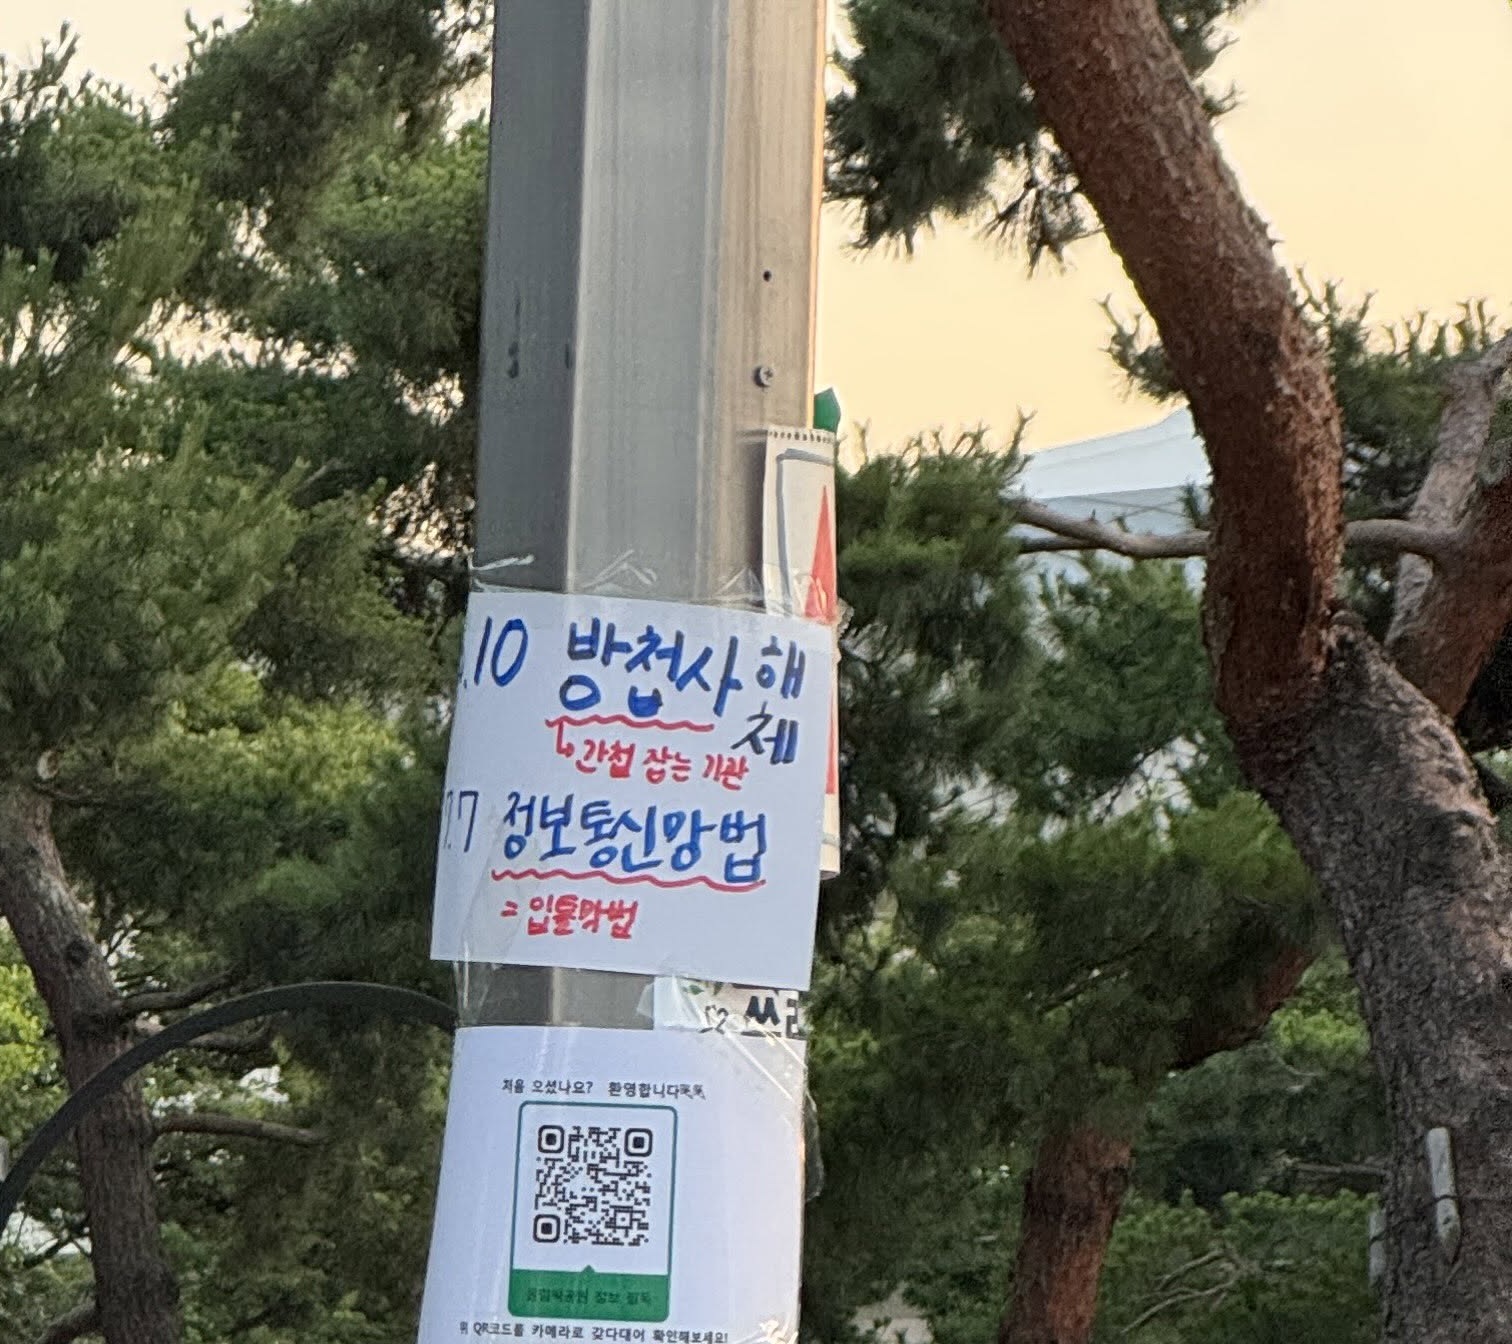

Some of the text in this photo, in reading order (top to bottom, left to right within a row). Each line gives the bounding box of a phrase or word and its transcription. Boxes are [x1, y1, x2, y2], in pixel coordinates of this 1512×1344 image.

[558, 616, 743, 717] 방첩사
[574, 738, 749, 791] 간첩 잡는 기관
[502, 791, 768, 884] 정보통신망법
[501, 1078, 525, 1095] 처음
[531, 1079, 594, 1096] 오셨나요?
[472, 1321, 525, 1337] QR코드를
[531, 1323, 585, 1341] 카메라로
[591, 1326, 646, 1343] 갖다대어
